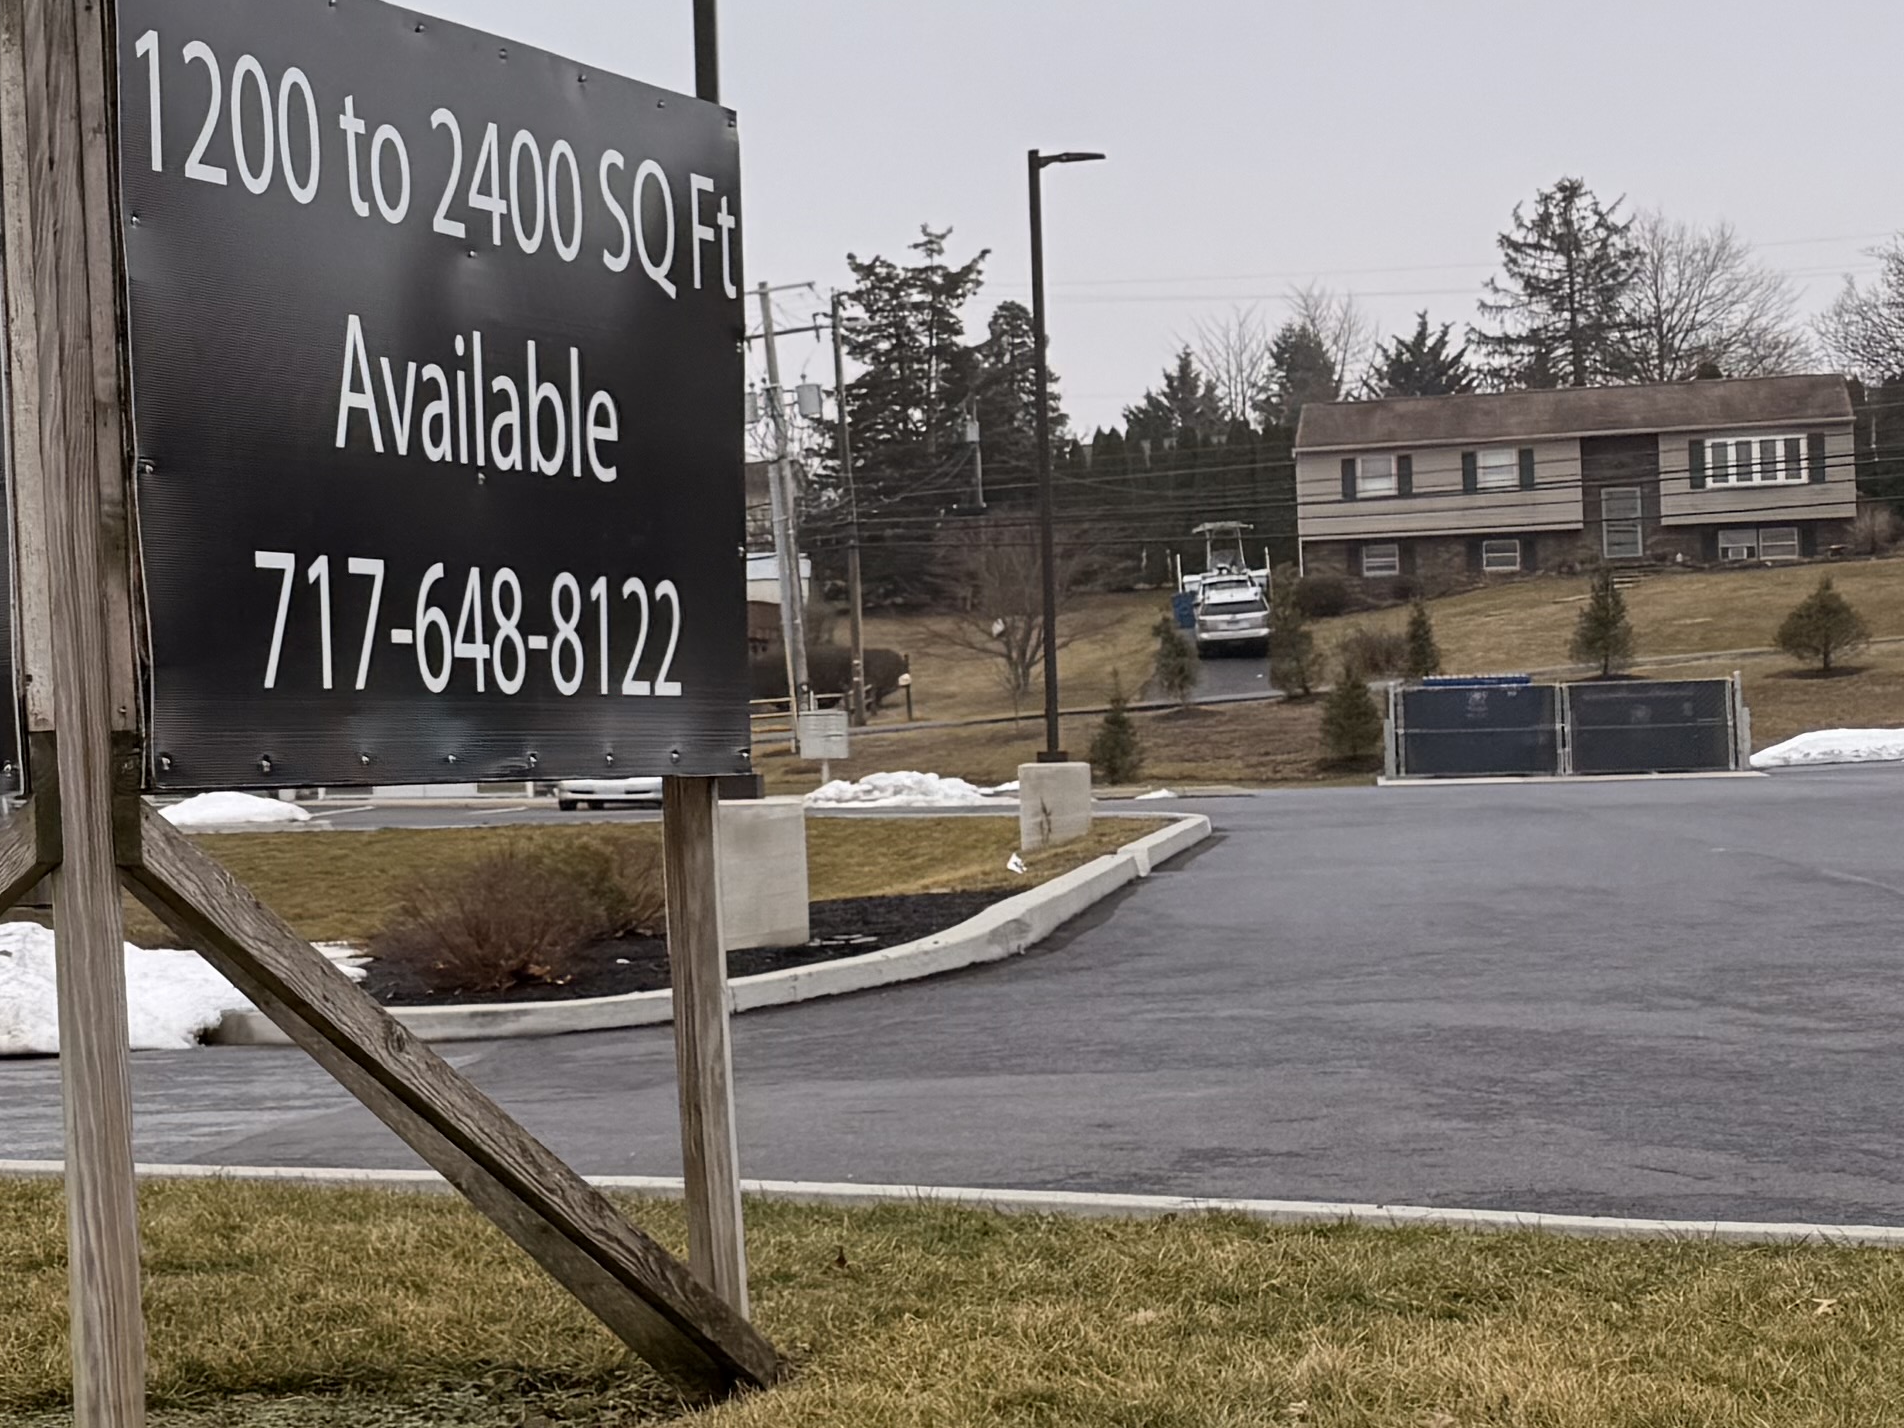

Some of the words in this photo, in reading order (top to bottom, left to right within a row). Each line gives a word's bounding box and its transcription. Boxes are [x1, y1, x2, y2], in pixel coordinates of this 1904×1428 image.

[135, 29, 320, 205] 1200
[339, 94, 411, 224] to
[430, 107, 583, 262] 2400
[599, 149, 677, 299] SQ
[690, 173, 737, 299] Ft
[335, 314, 619, 482] Available
[255, 550, 682, 696] 717-648-8122
